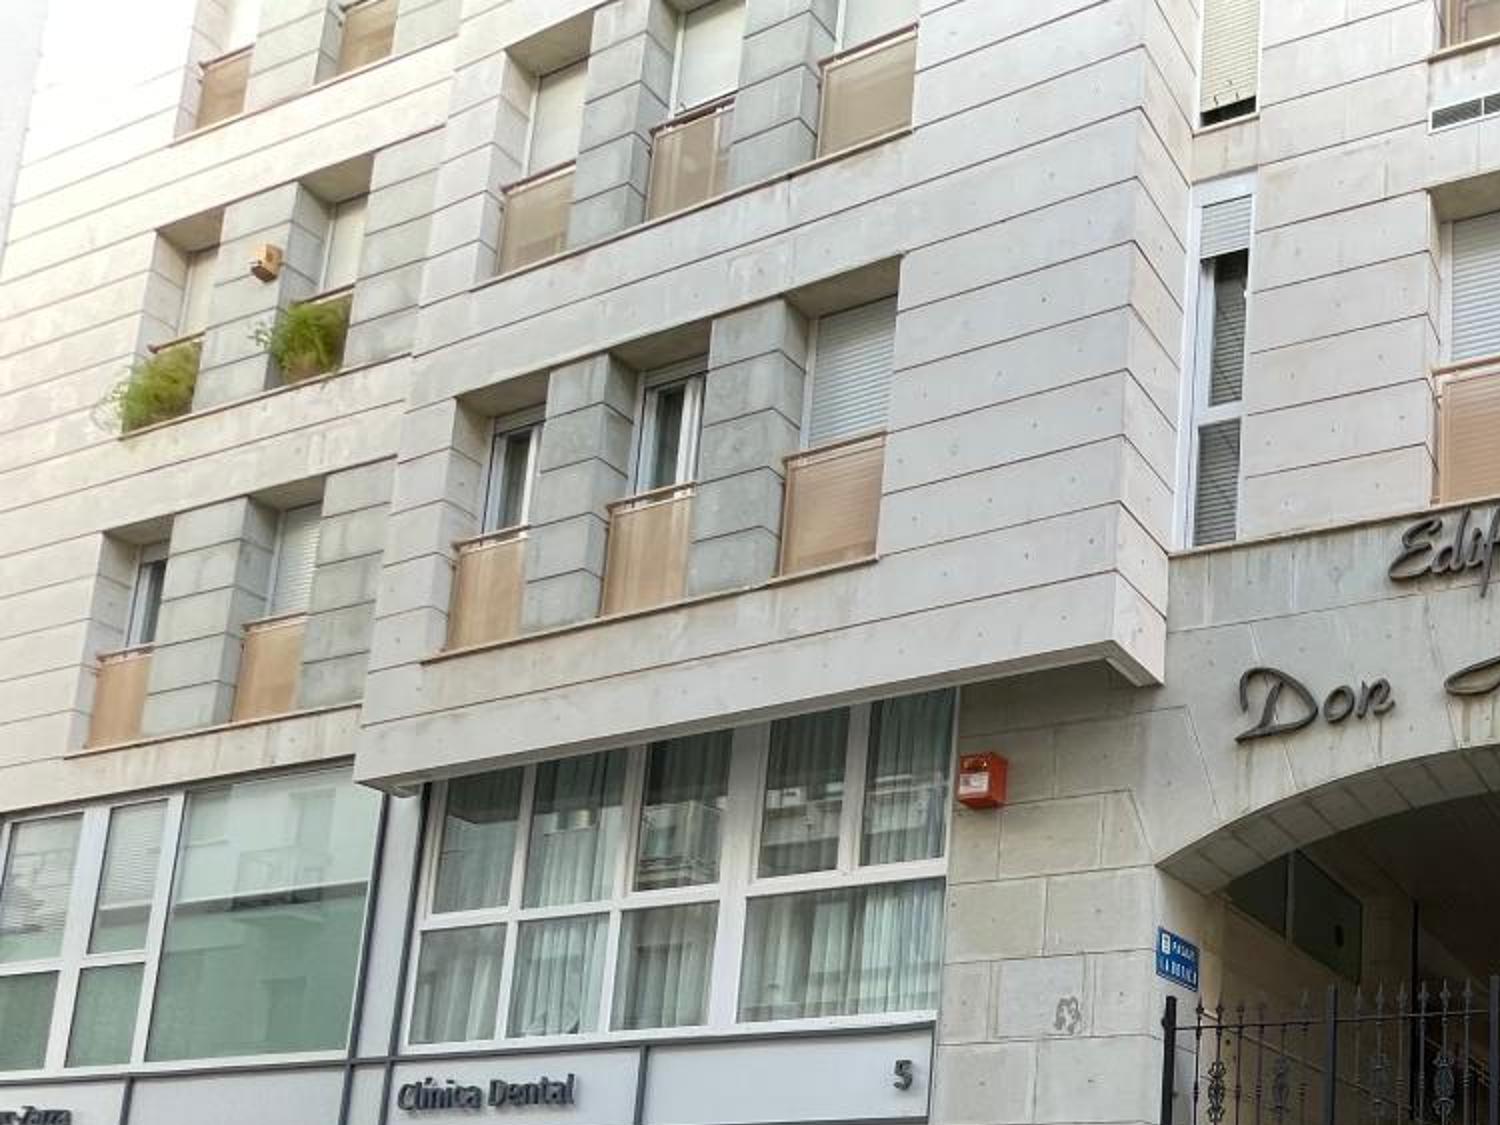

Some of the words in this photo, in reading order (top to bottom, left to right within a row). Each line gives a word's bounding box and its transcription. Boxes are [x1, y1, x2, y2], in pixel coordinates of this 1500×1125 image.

[1235, 666, 1395, 743] Don
[398, 1077, 483, 1110] Clínica
[487, 1073, 576, 1106] Dental
[894, 1060, 912, 1091] 5
